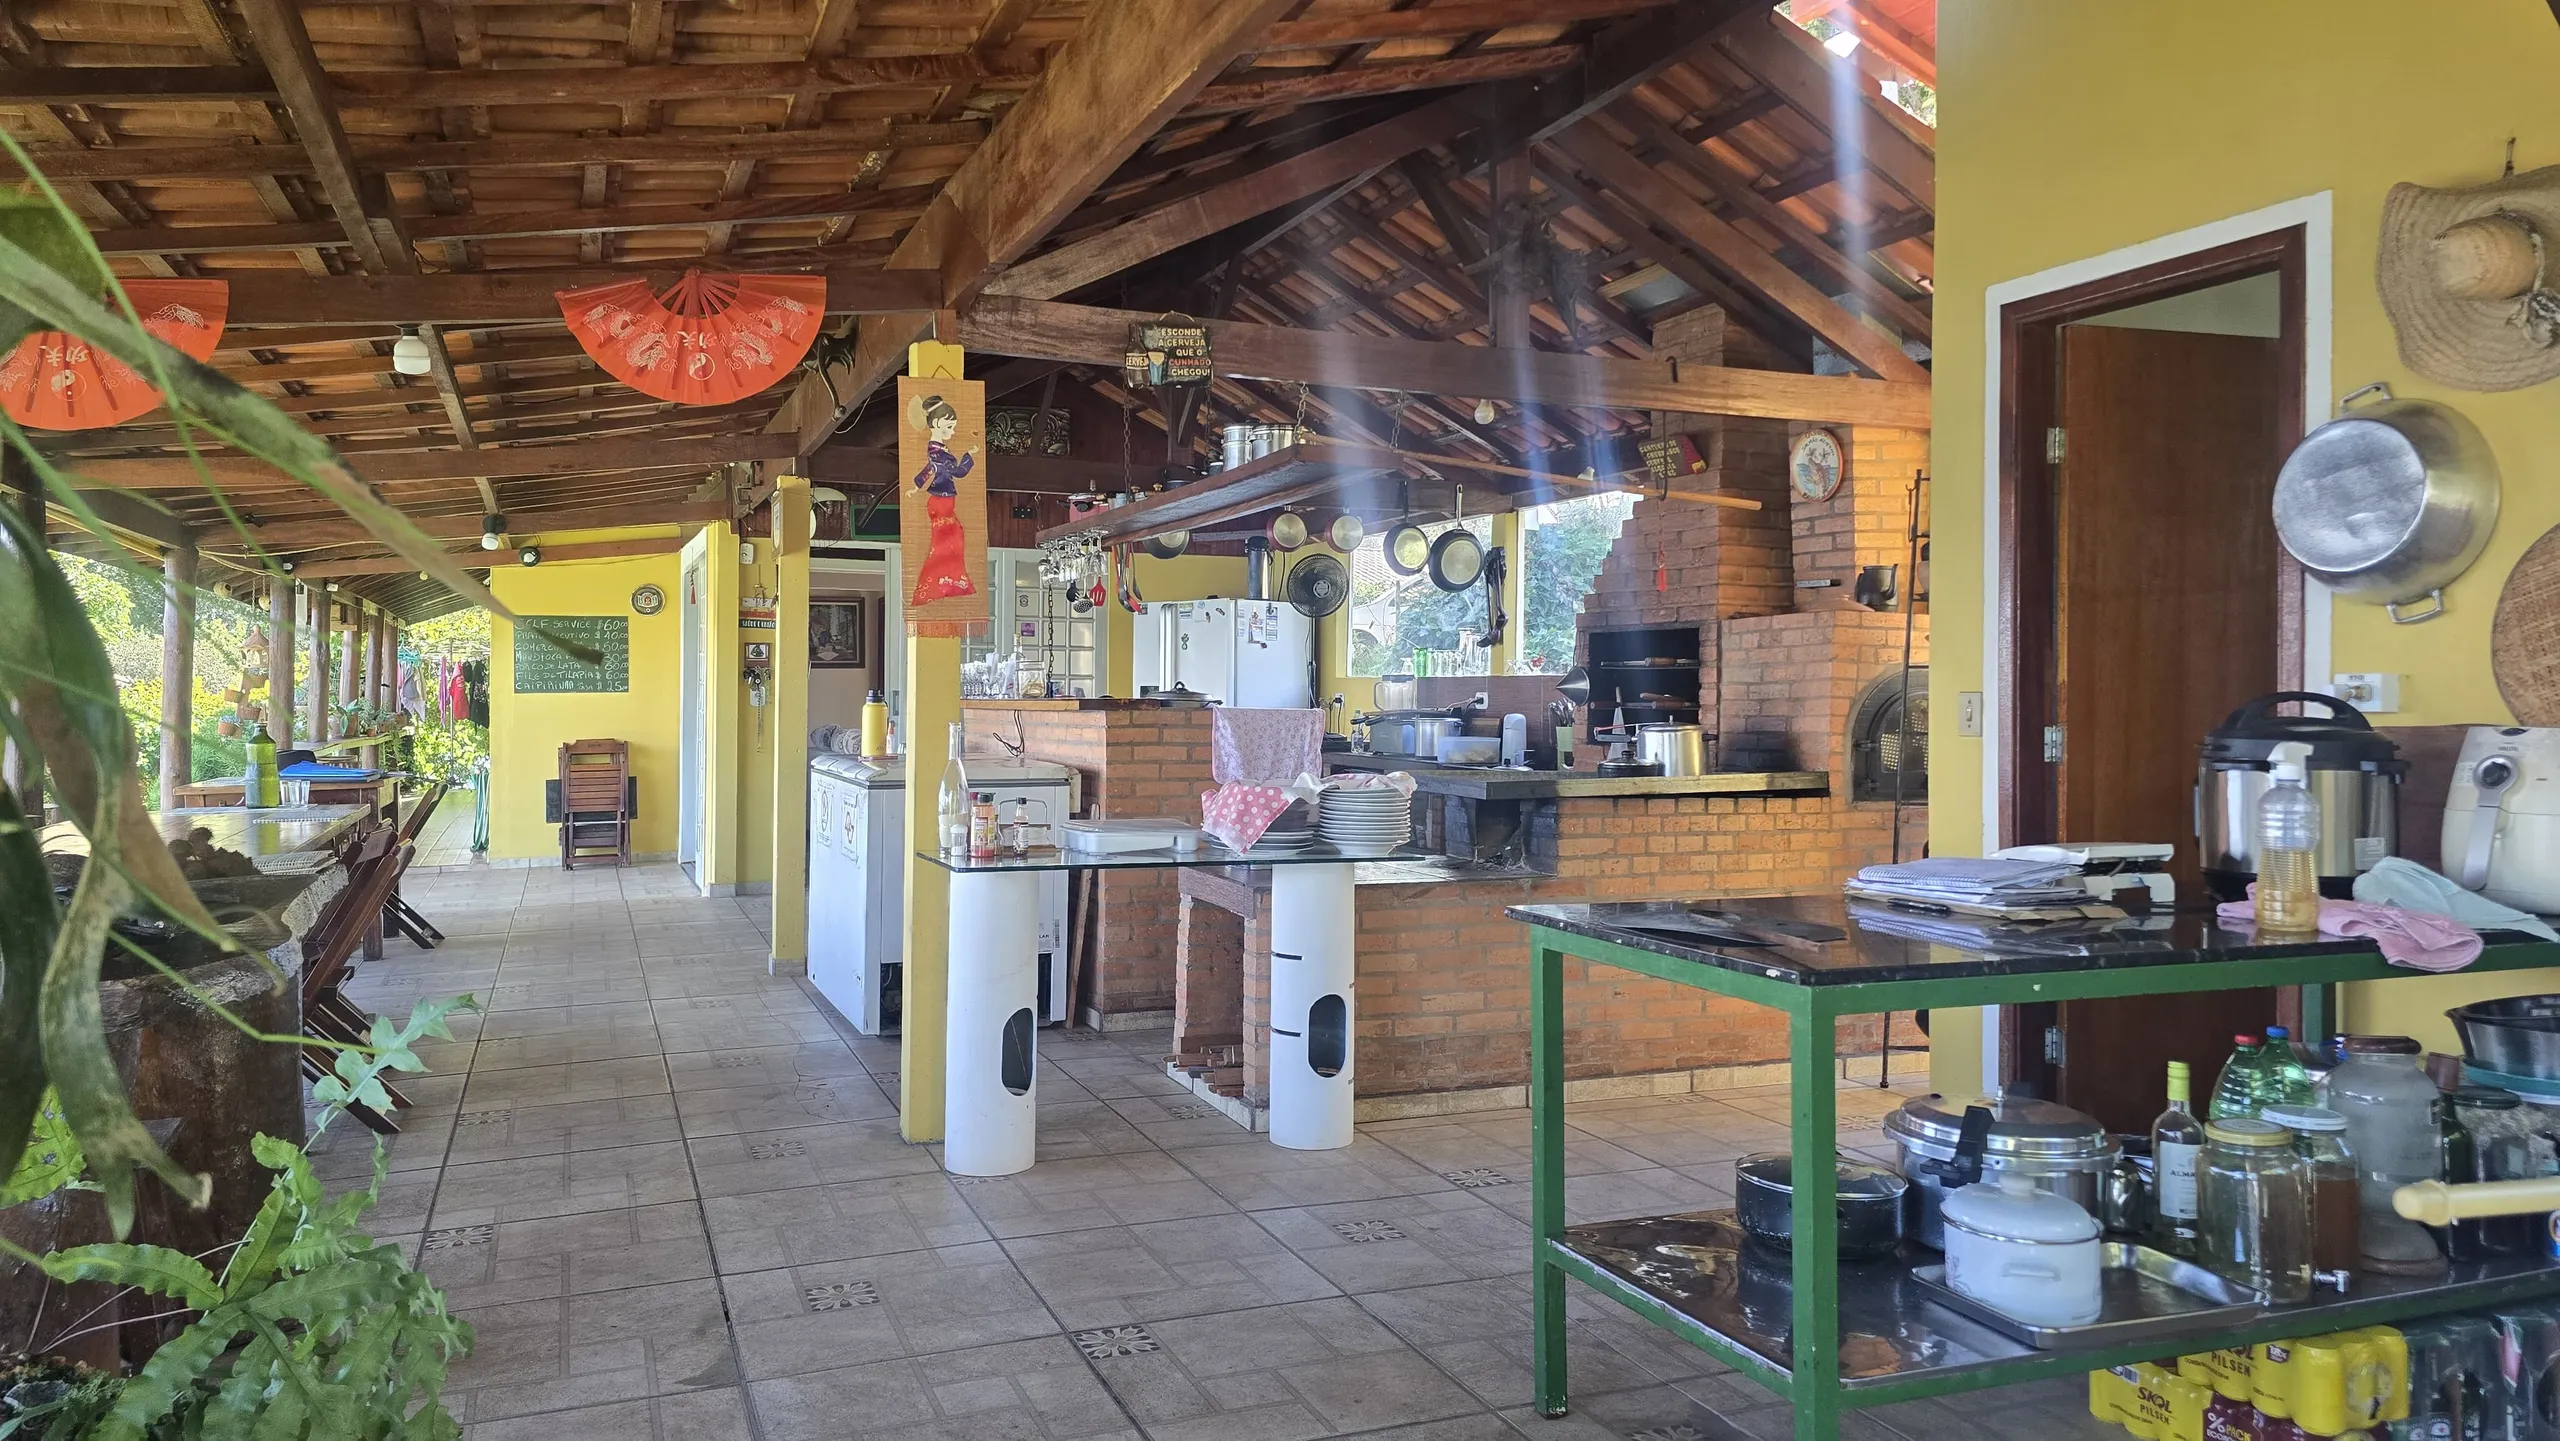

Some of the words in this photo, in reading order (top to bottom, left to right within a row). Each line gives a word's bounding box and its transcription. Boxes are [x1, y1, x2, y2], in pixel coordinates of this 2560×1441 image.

[1161, 328, 1202, 336] ESCONDE
[1158, 338, 1164, 347] A
[1166, 338, 1206, 347] CERVEJA
[1176, 348, 1194, 357] QUE
[1196, 348, 1203, 356] O
[1168, 358, 1212, 366] CUNHADO
[1171, 368, 1210, 376] CHEGOU!
[2211, 1350, 2250, 1376] PILSEN
[2137, 1386, 2173, 1414] SKOL
[2140, 1404, 2170, 1425] PILSEN
